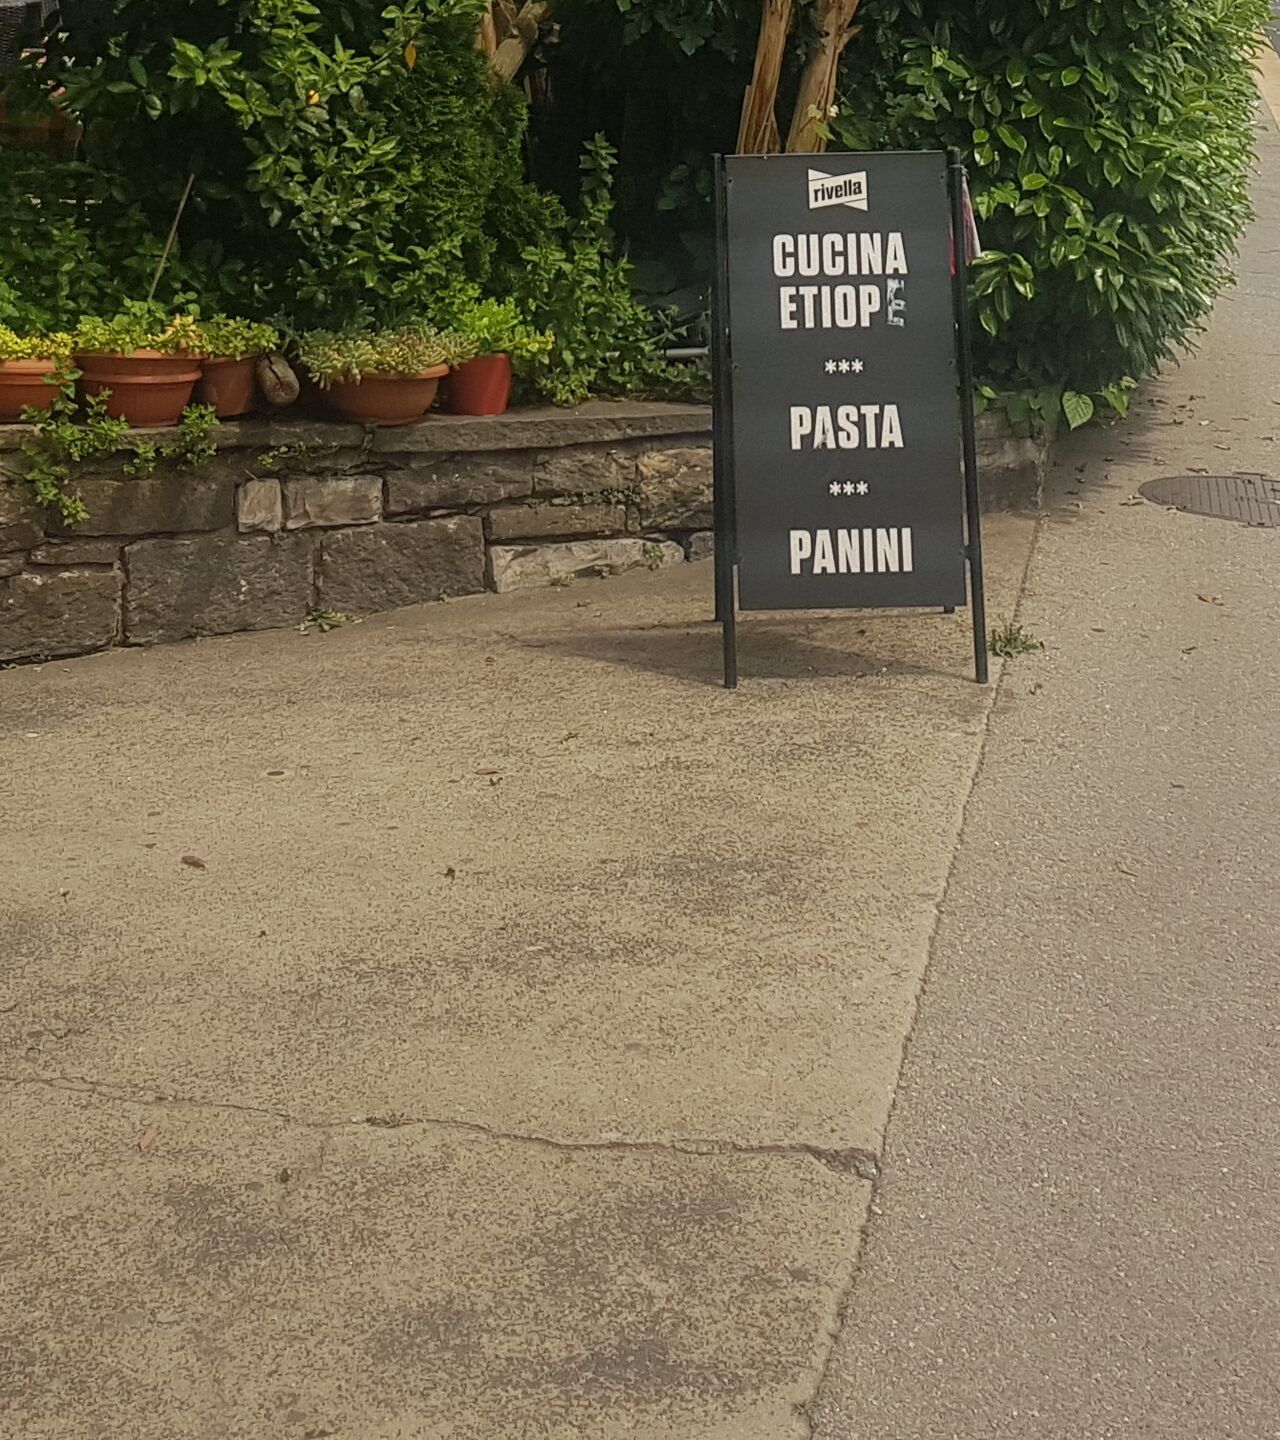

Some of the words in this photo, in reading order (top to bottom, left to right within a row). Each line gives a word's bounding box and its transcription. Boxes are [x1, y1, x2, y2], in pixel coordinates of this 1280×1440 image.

[813, 179, 862, 203] rivella
[772, 231, 908, 278] CUCINA
[789, 403, 905, 451] PASTA
[789, 526, 914, 575] PANINI
